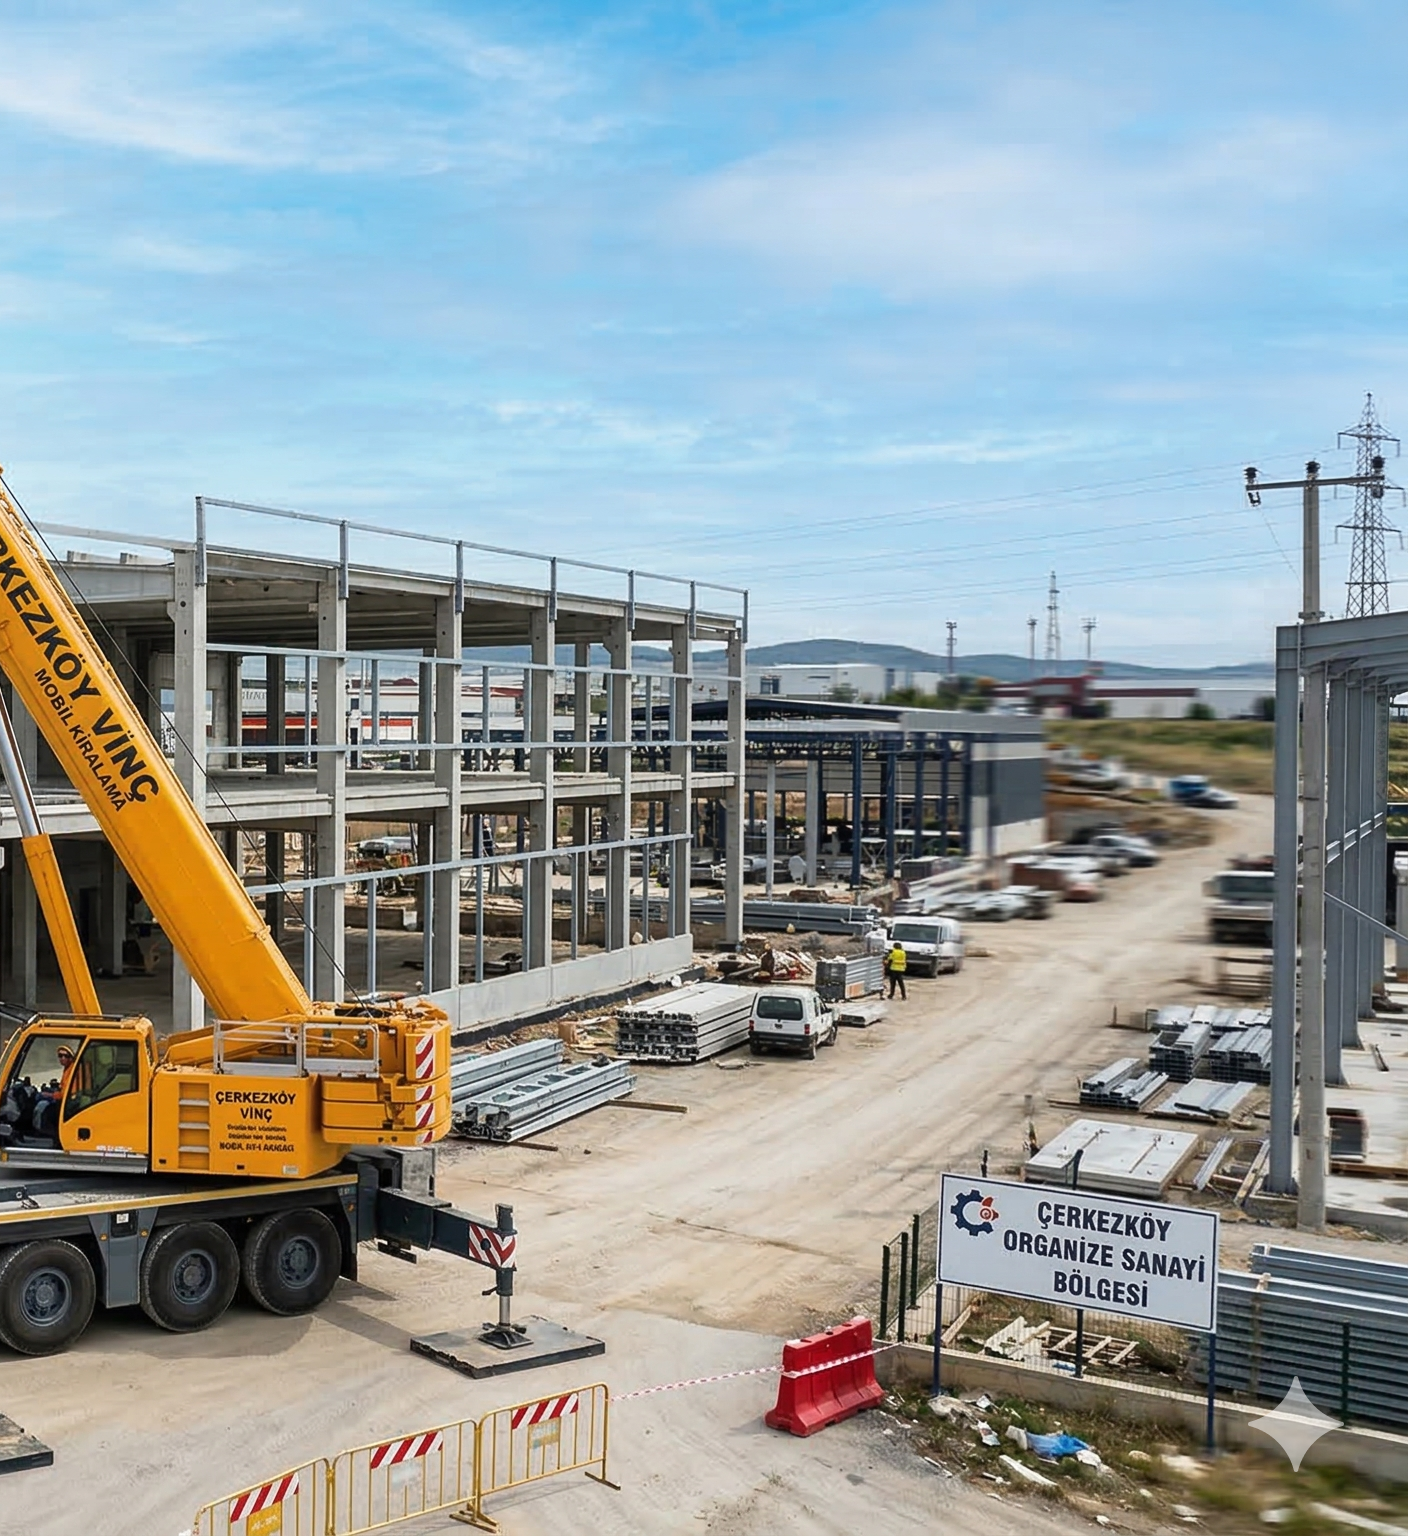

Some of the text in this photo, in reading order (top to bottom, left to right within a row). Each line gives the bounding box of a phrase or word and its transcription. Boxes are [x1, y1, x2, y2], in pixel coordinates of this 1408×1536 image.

[34, 668, 127, 812] MOBİL KİRALAMA
[215, 1090, 296, 1105] ÇERKEZKÖY
[1037, 1201, 1172, 1243] ÇERKEZKÖY
[1003, 1229, 1206, 1283] ORGANİZE SANAYİ
[1053, 1268, 1148, 1308] BÖLGESİ
